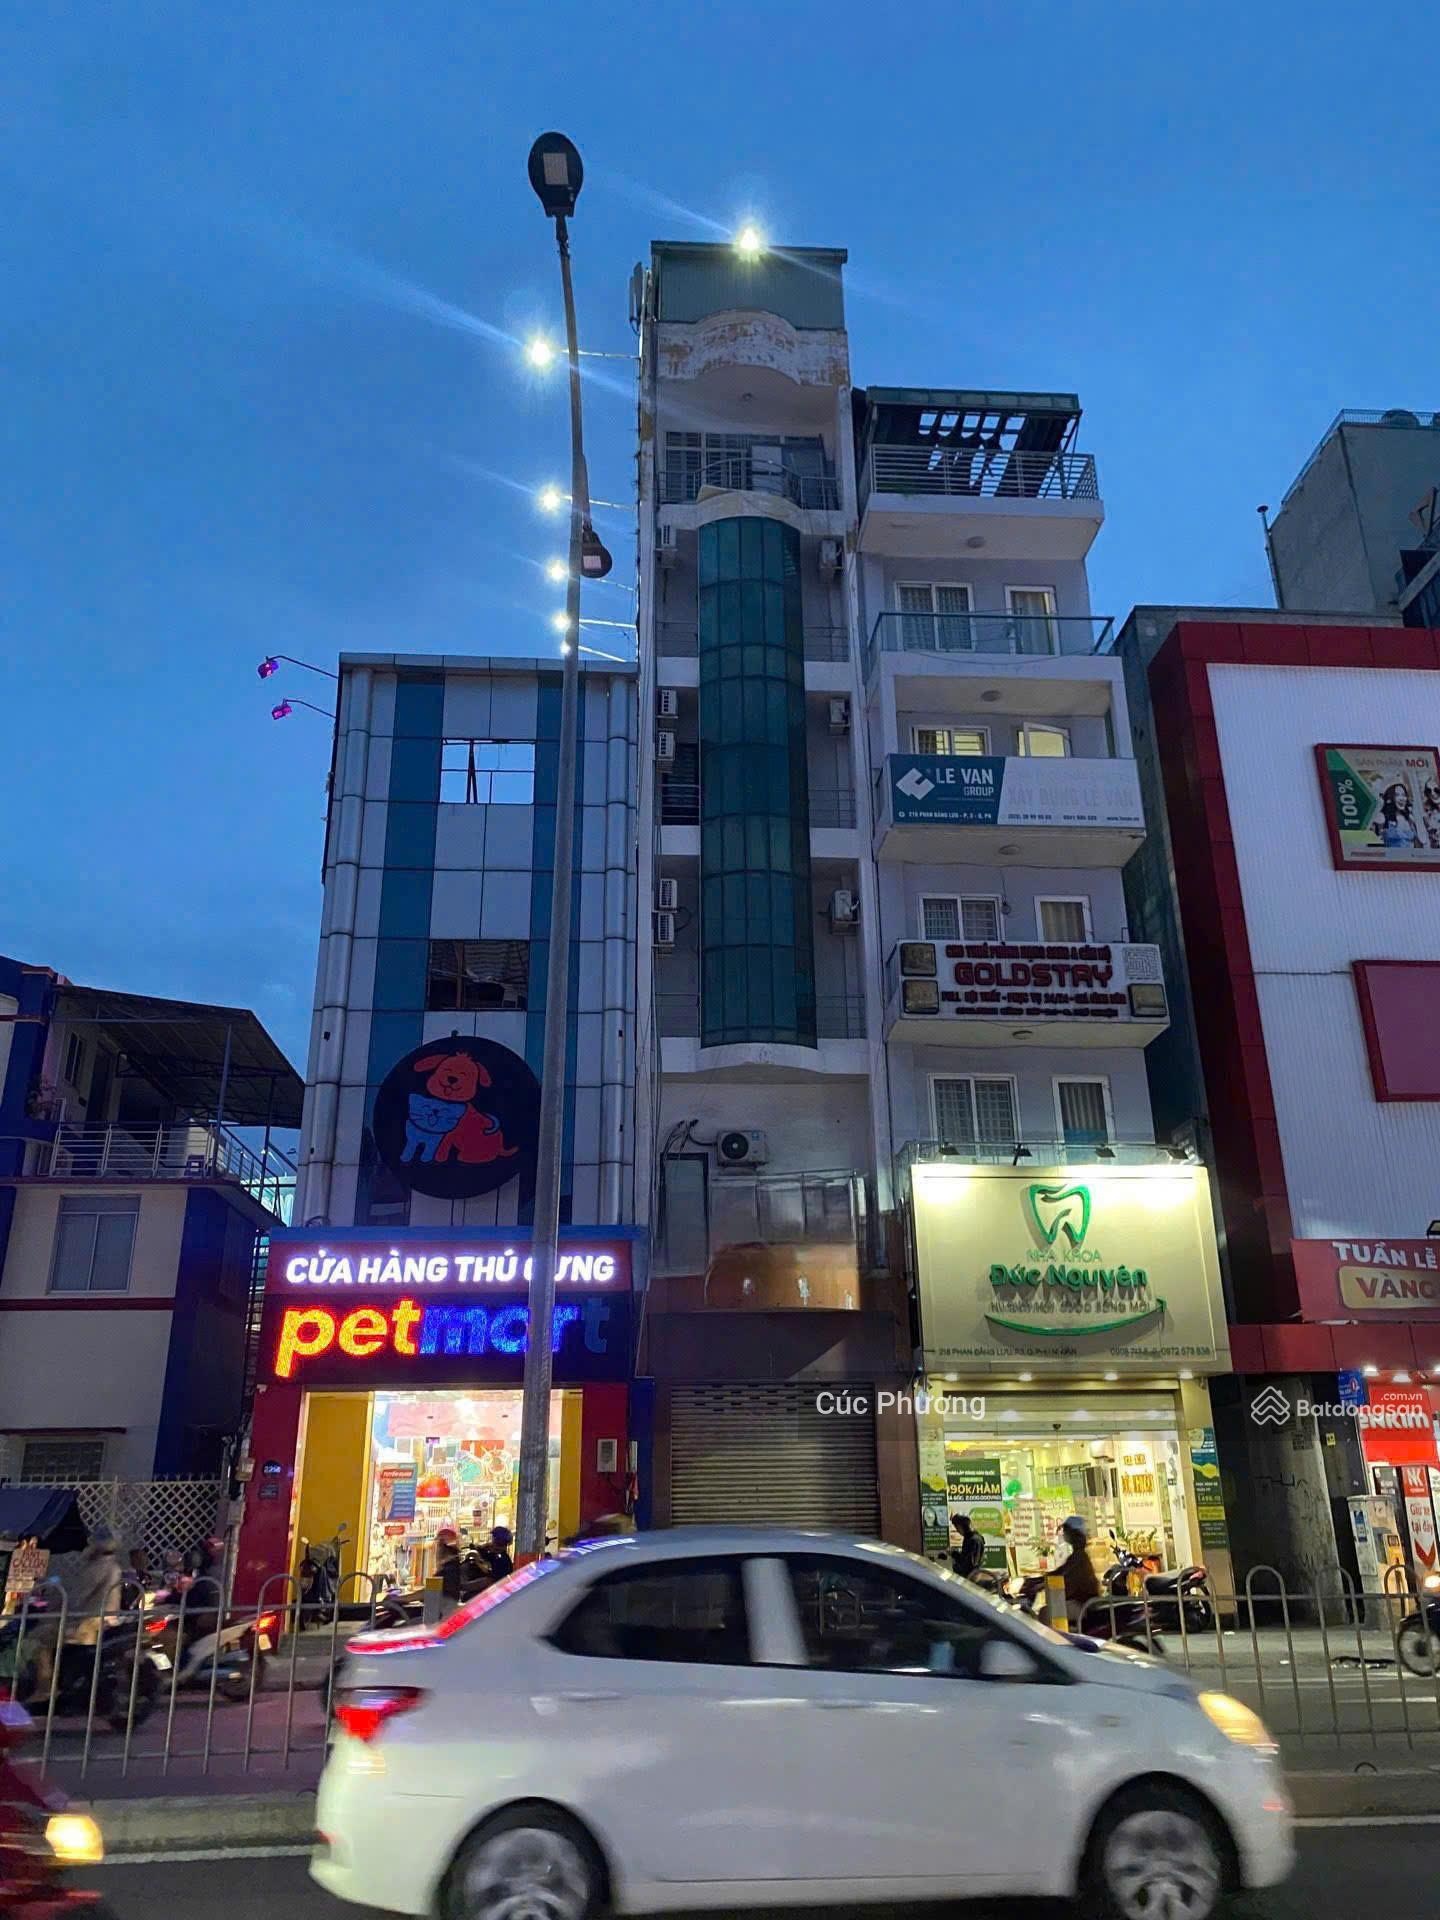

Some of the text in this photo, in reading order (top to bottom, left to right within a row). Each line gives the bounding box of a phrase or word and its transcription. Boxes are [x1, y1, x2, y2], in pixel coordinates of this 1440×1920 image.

[936, 768, 993, 784] LE VAN
[964, 786, 994, 796] GROUP
[1337, 779, 1360, 826] 100%
[1064, 1250, 1102, 1262] KHOA
[1332, 1241, 1408, 1266] TUẦN
[286, 1249, 353, 1283] CỬA
[358, 1249, 448, 1283] HÀNG
[454, 1248, 519, 1282] THÚ
